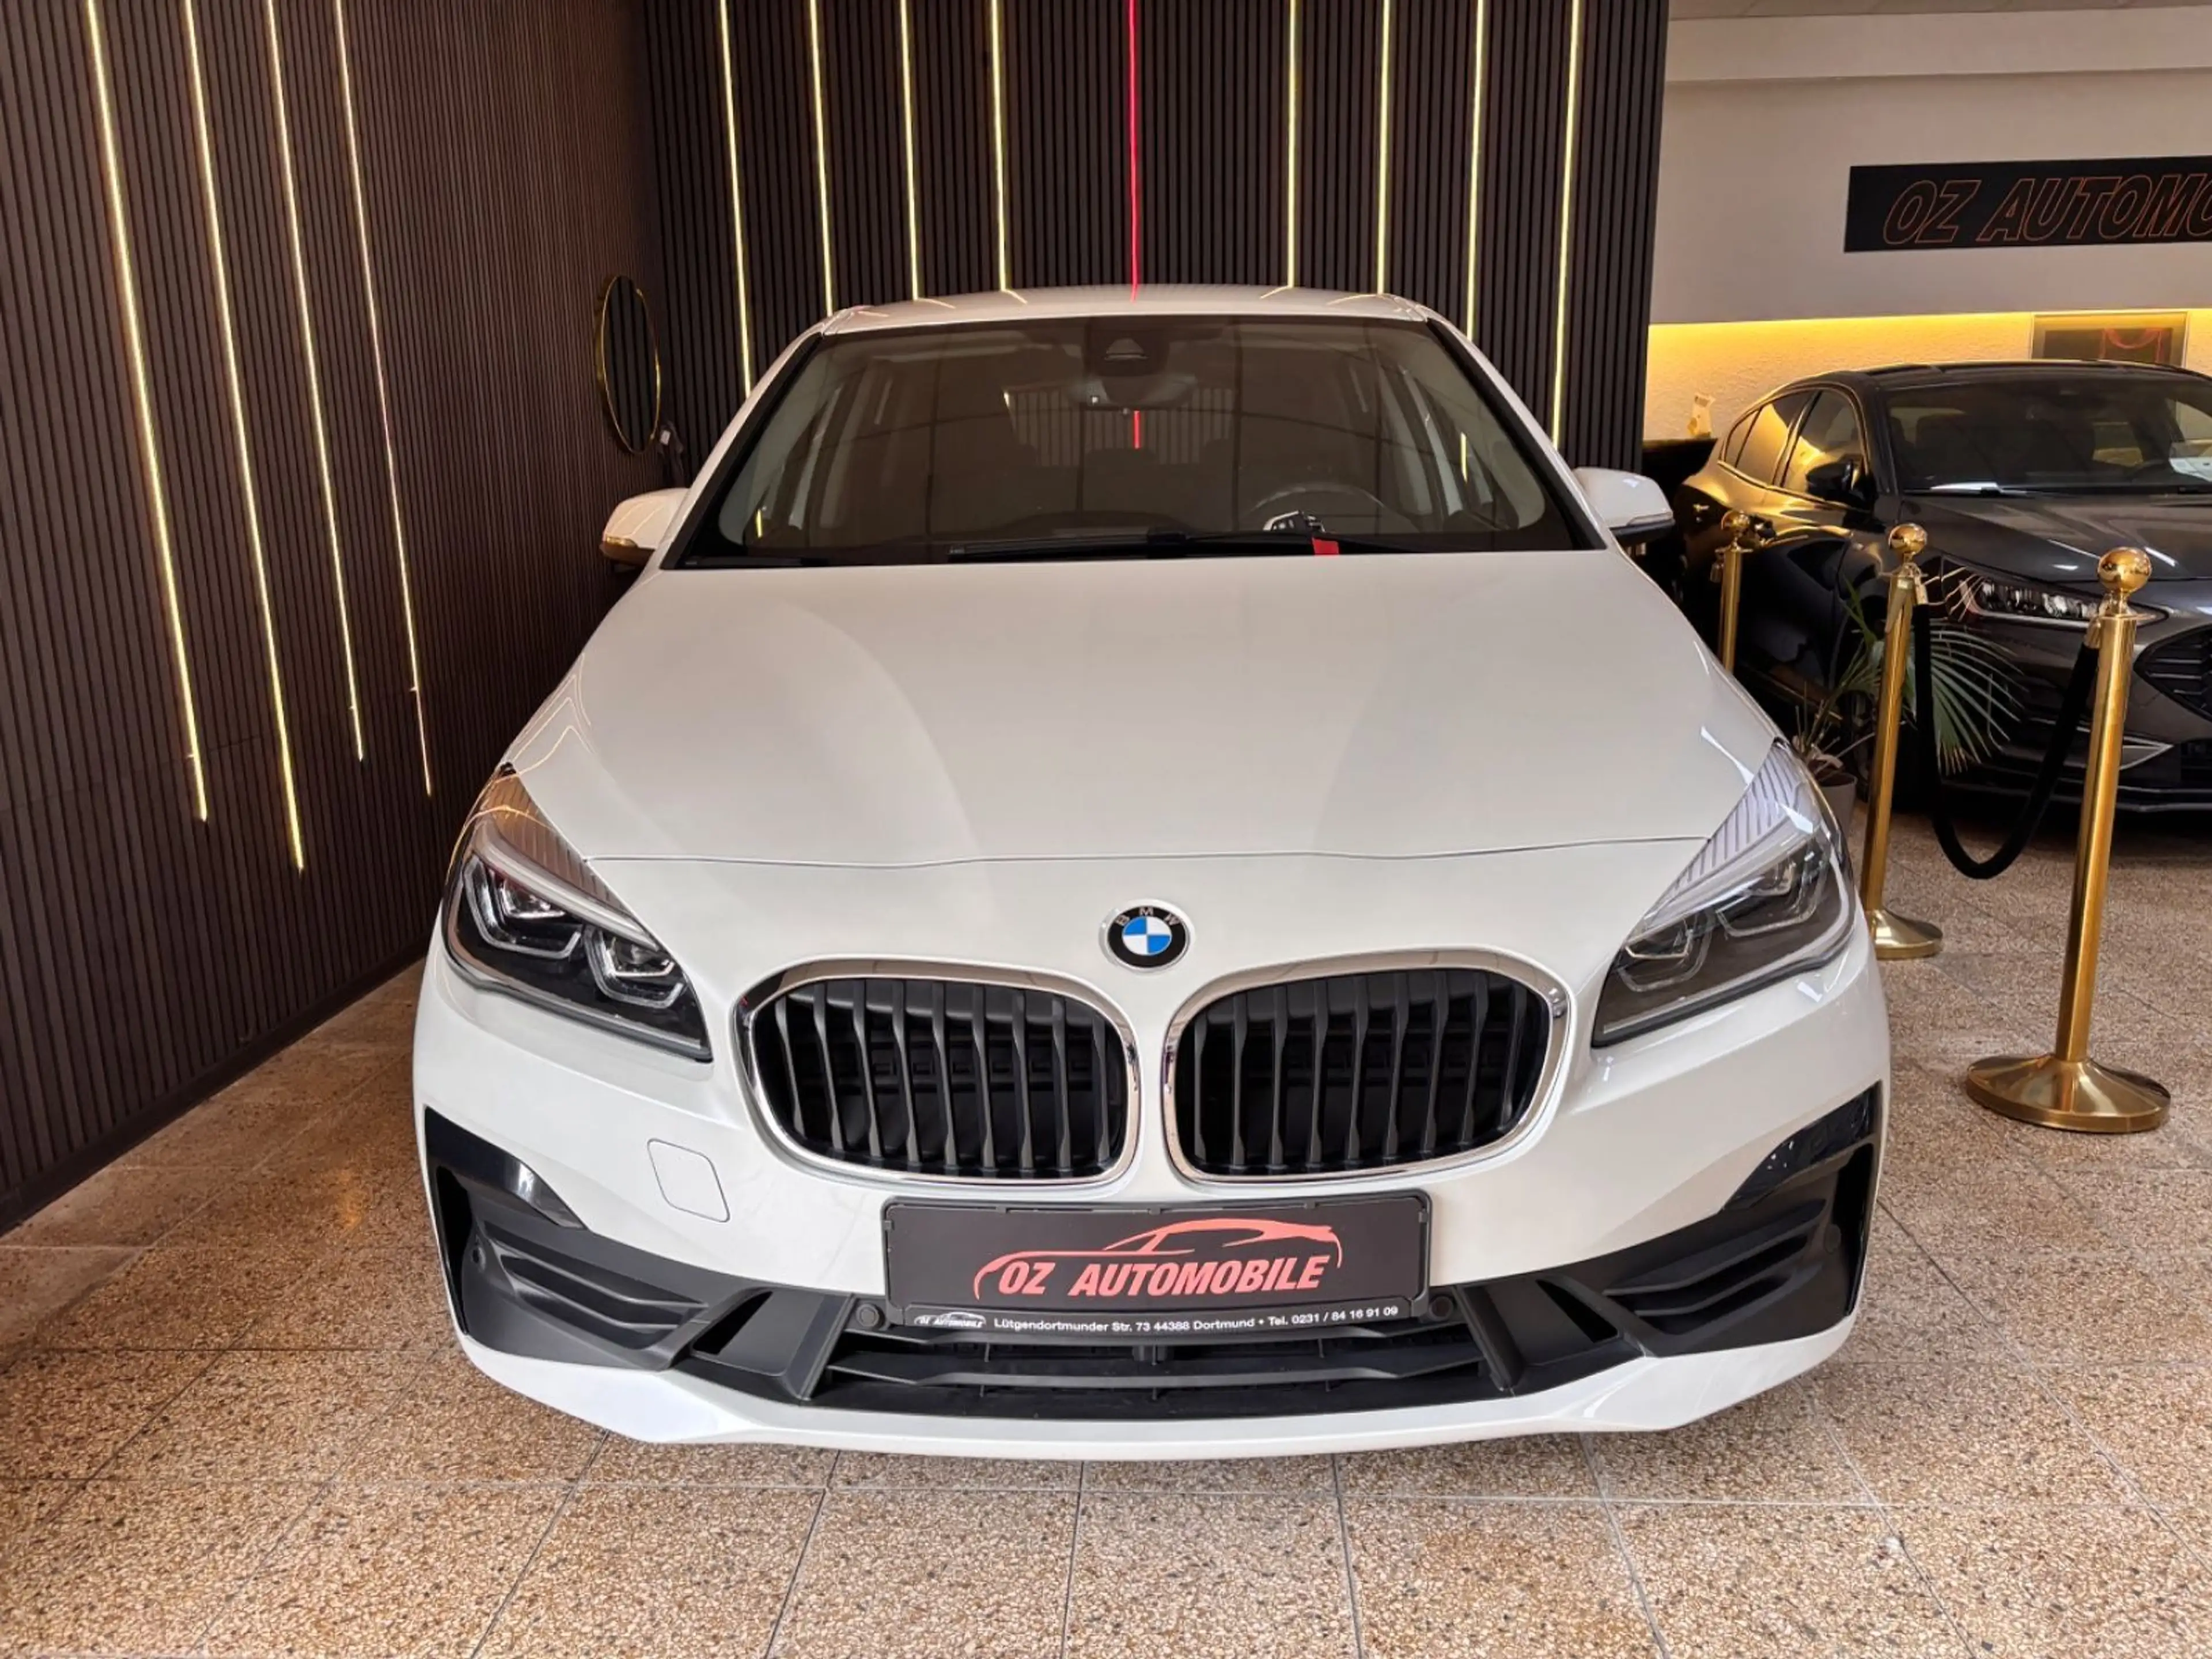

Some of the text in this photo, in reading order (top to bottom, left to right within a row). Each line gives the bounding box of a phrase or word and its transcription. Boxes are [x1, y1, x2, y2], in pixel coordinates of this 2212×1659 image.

[1883, 179, 1982, 245] OZ
[1115, 907, 1181, 926] BMW
[998, 1255, 1330, 1297] OZ AUTOMOBILE
[994, 1317, 1108, 1332] Lütgendortmunder
[1112, 1321, 1132, 1332] Str.
[1135, 1321, 1151, 1332] 73
[1153, 1320, 1190, 1331] 44388
[1193, 1316, 1256, 1330] Dortmund
[1268, 1316, 1288, 1326] Tel.
[1291, 1313, 1319, 1324] 0231
[1331, 1310, 1346, 1321] 84
[1366, 1307, 1380, 1317] 91
